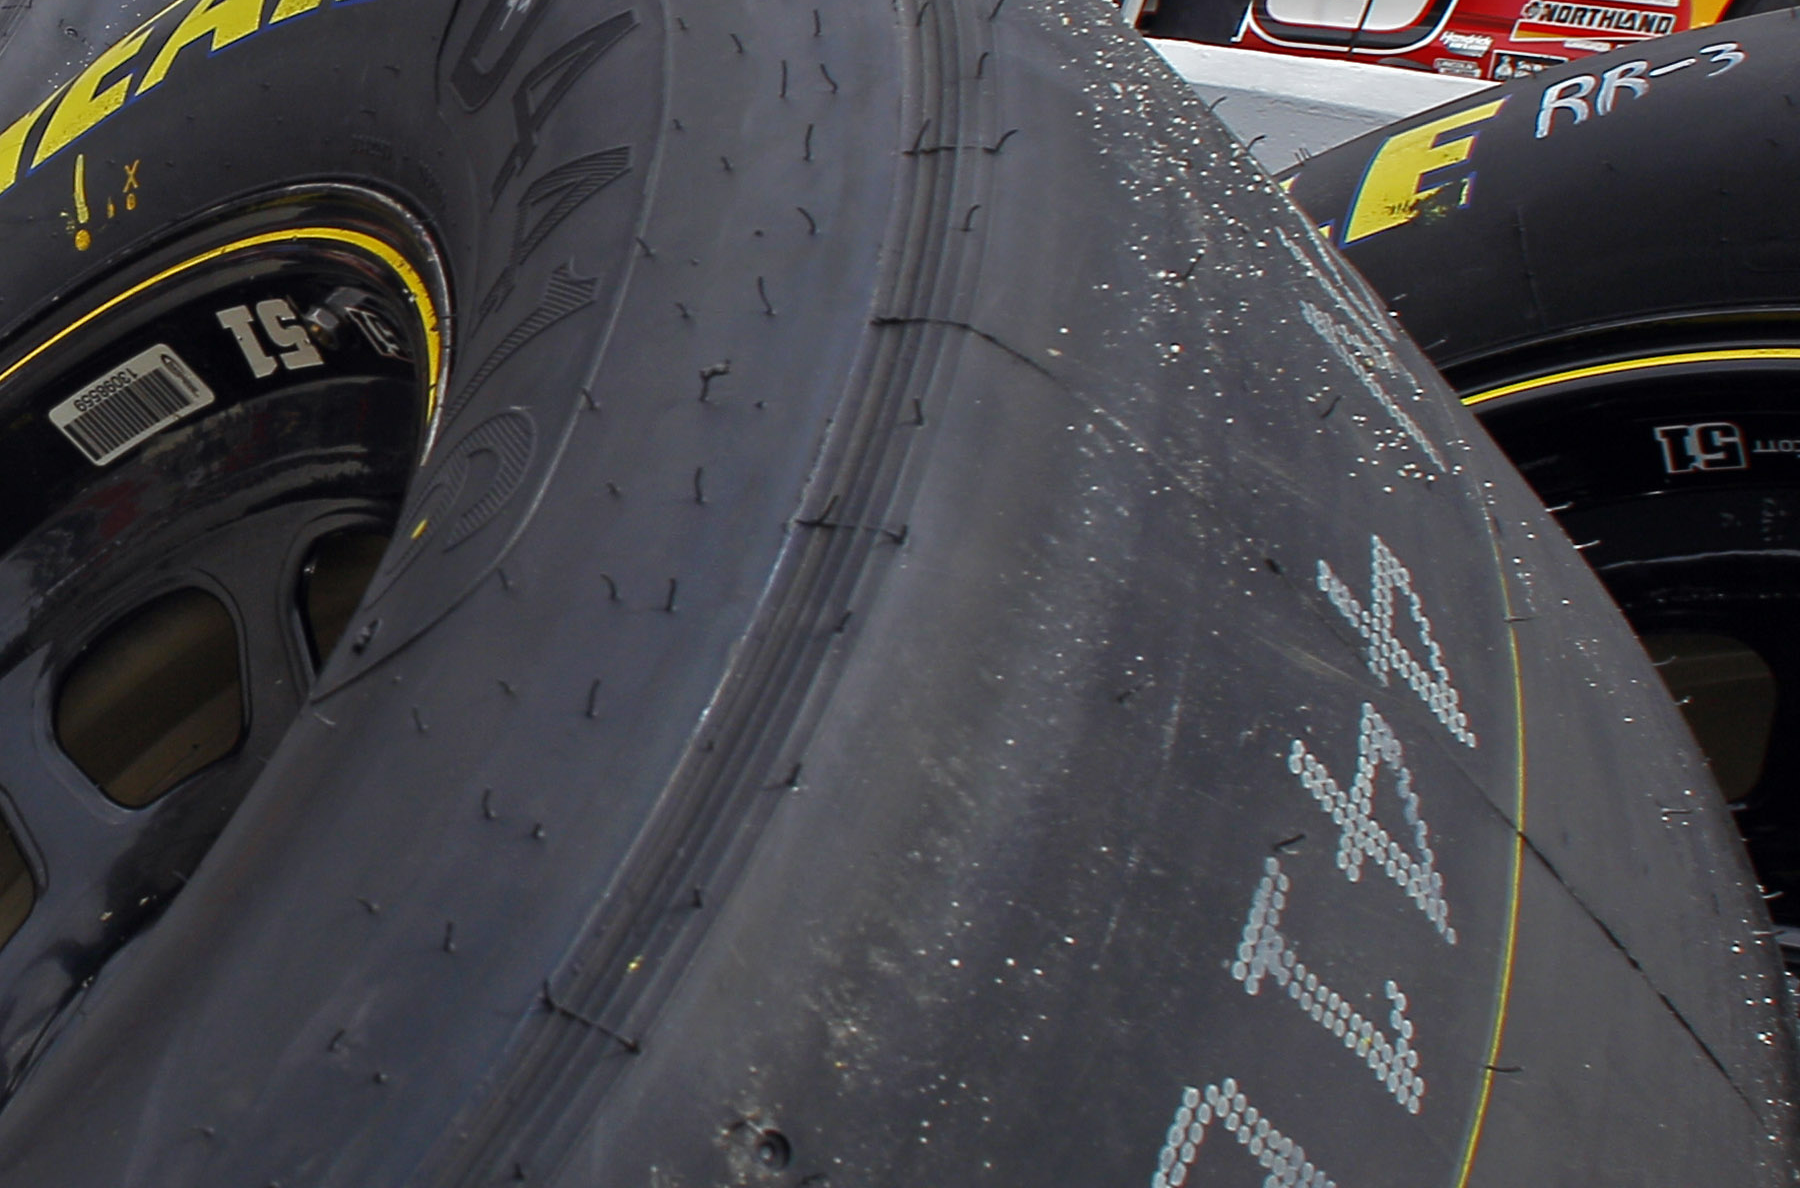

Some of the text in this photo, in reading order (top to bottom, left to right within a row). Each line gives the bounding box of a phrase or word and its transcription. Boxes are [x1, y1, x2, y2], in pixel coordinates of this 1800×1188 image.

[1541, 2, 1675, 35] NORTHLAND
[1536, 42, 1746, 139] RR-3
[215, 297, 325, 379] 51
[73, 367, 139, 413] 13098559
[1652, 421, 1749, 475] 51
